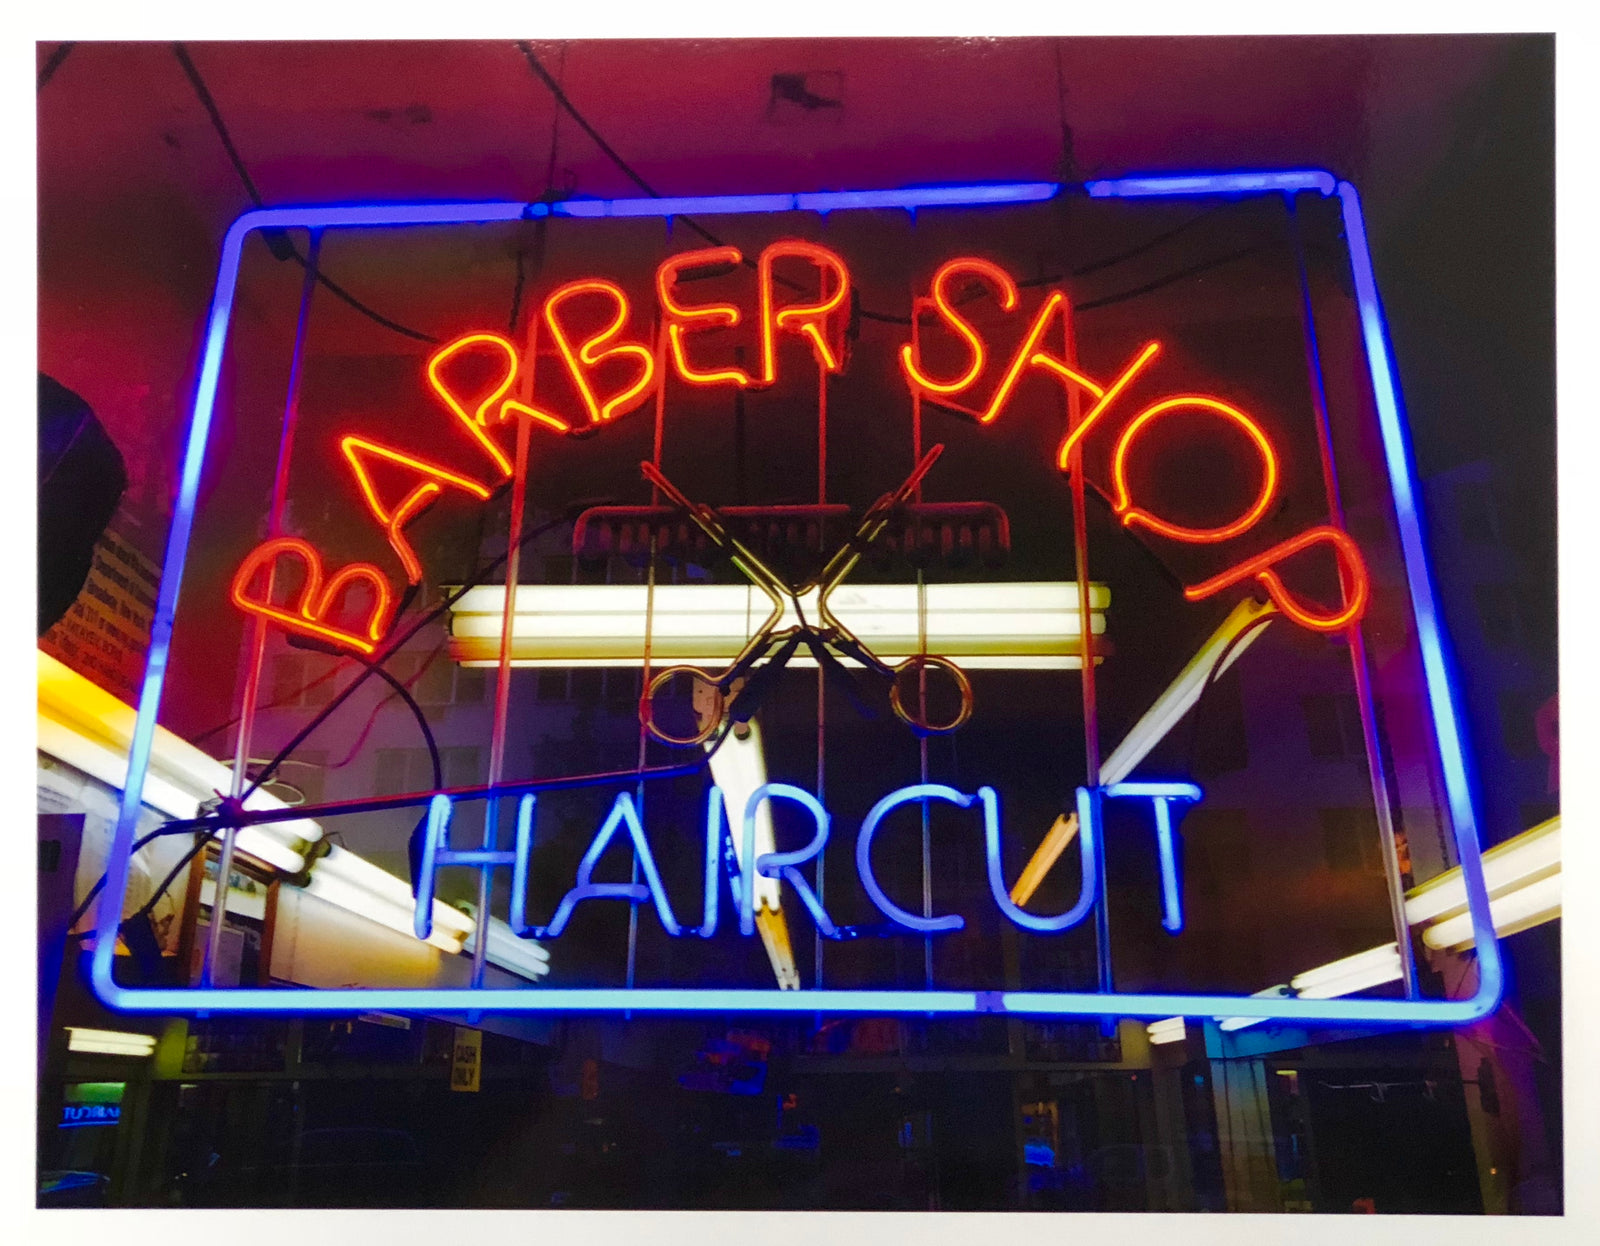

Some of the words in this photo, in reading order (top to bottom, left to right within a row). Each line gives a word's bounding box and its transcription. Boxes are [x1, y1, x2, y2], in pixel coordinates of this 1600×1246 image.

[233, 241, 850, 653] BARBER
[900, 258, 1367, 631] SHOP
[412, 781, 1204, 940] HAIRCUT
